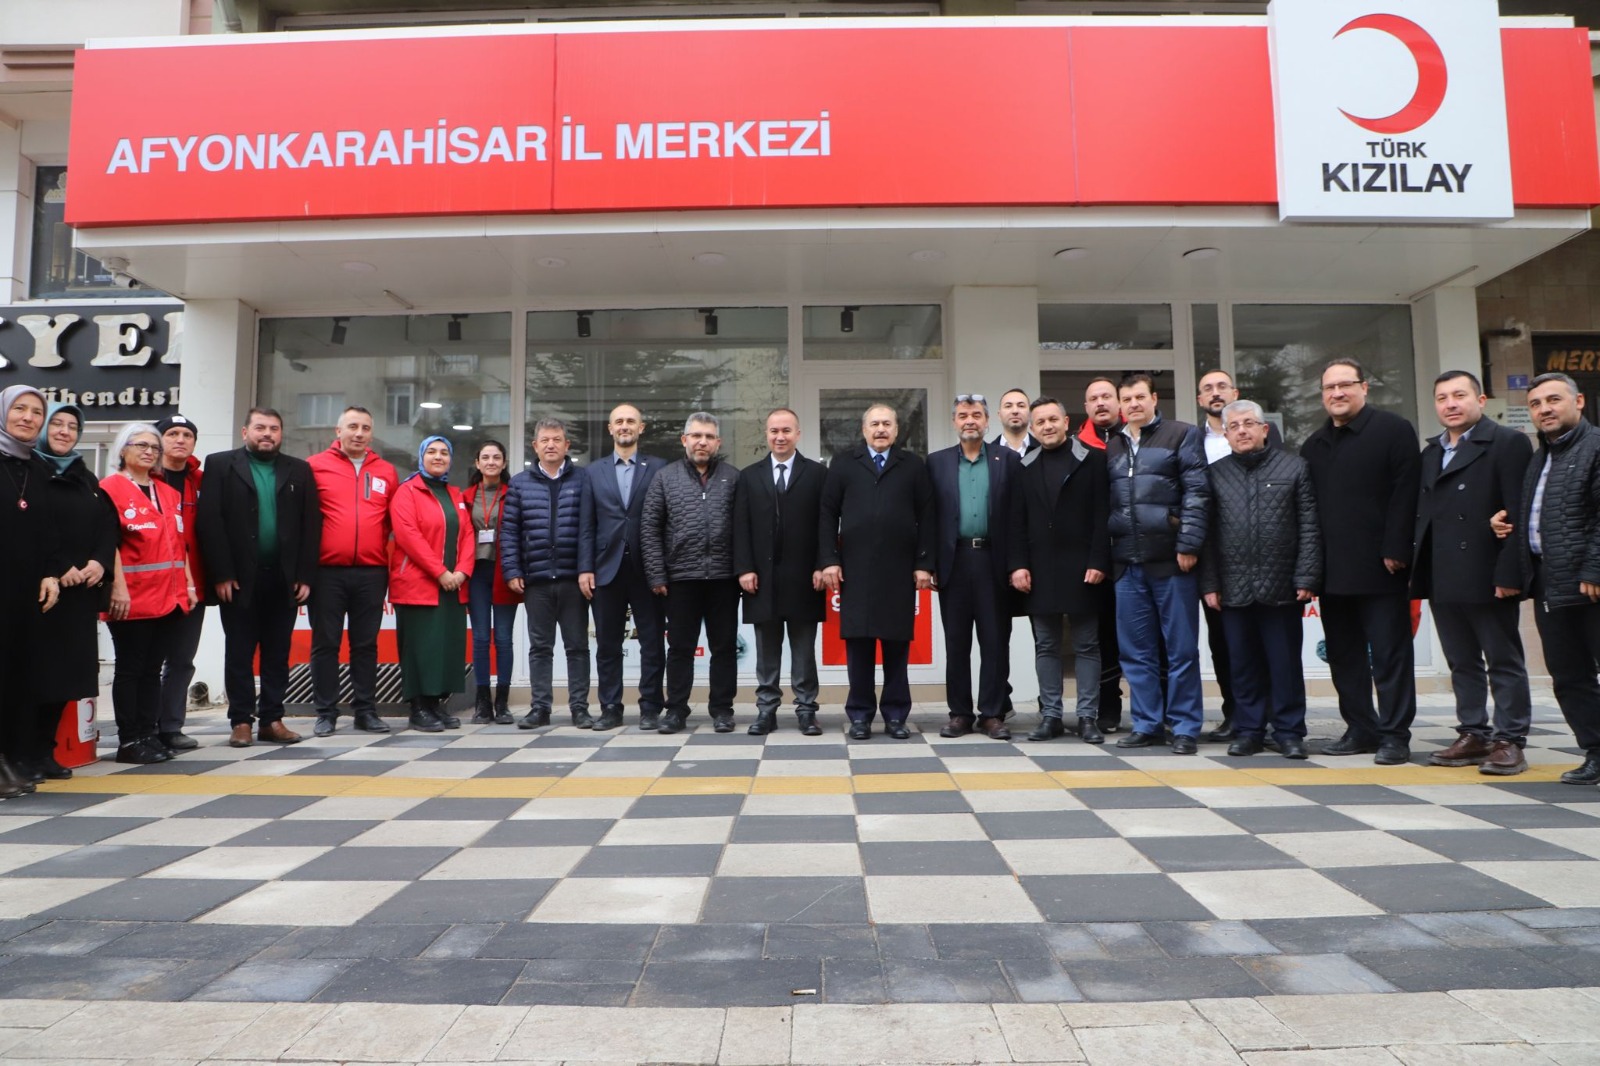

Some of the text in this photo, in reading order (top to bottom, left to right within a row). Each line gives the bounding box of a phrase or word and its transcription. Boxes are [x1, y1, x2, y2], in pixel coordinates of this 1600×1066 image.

[105, 110, 831, 174] AFYONKARAHİSAR İL MERKEZİ
[1366, 138, 1427, 158] TÜRK
[1321, 163, 1473, 193] KIZILAY
[0, 312, 184, 368] YE
